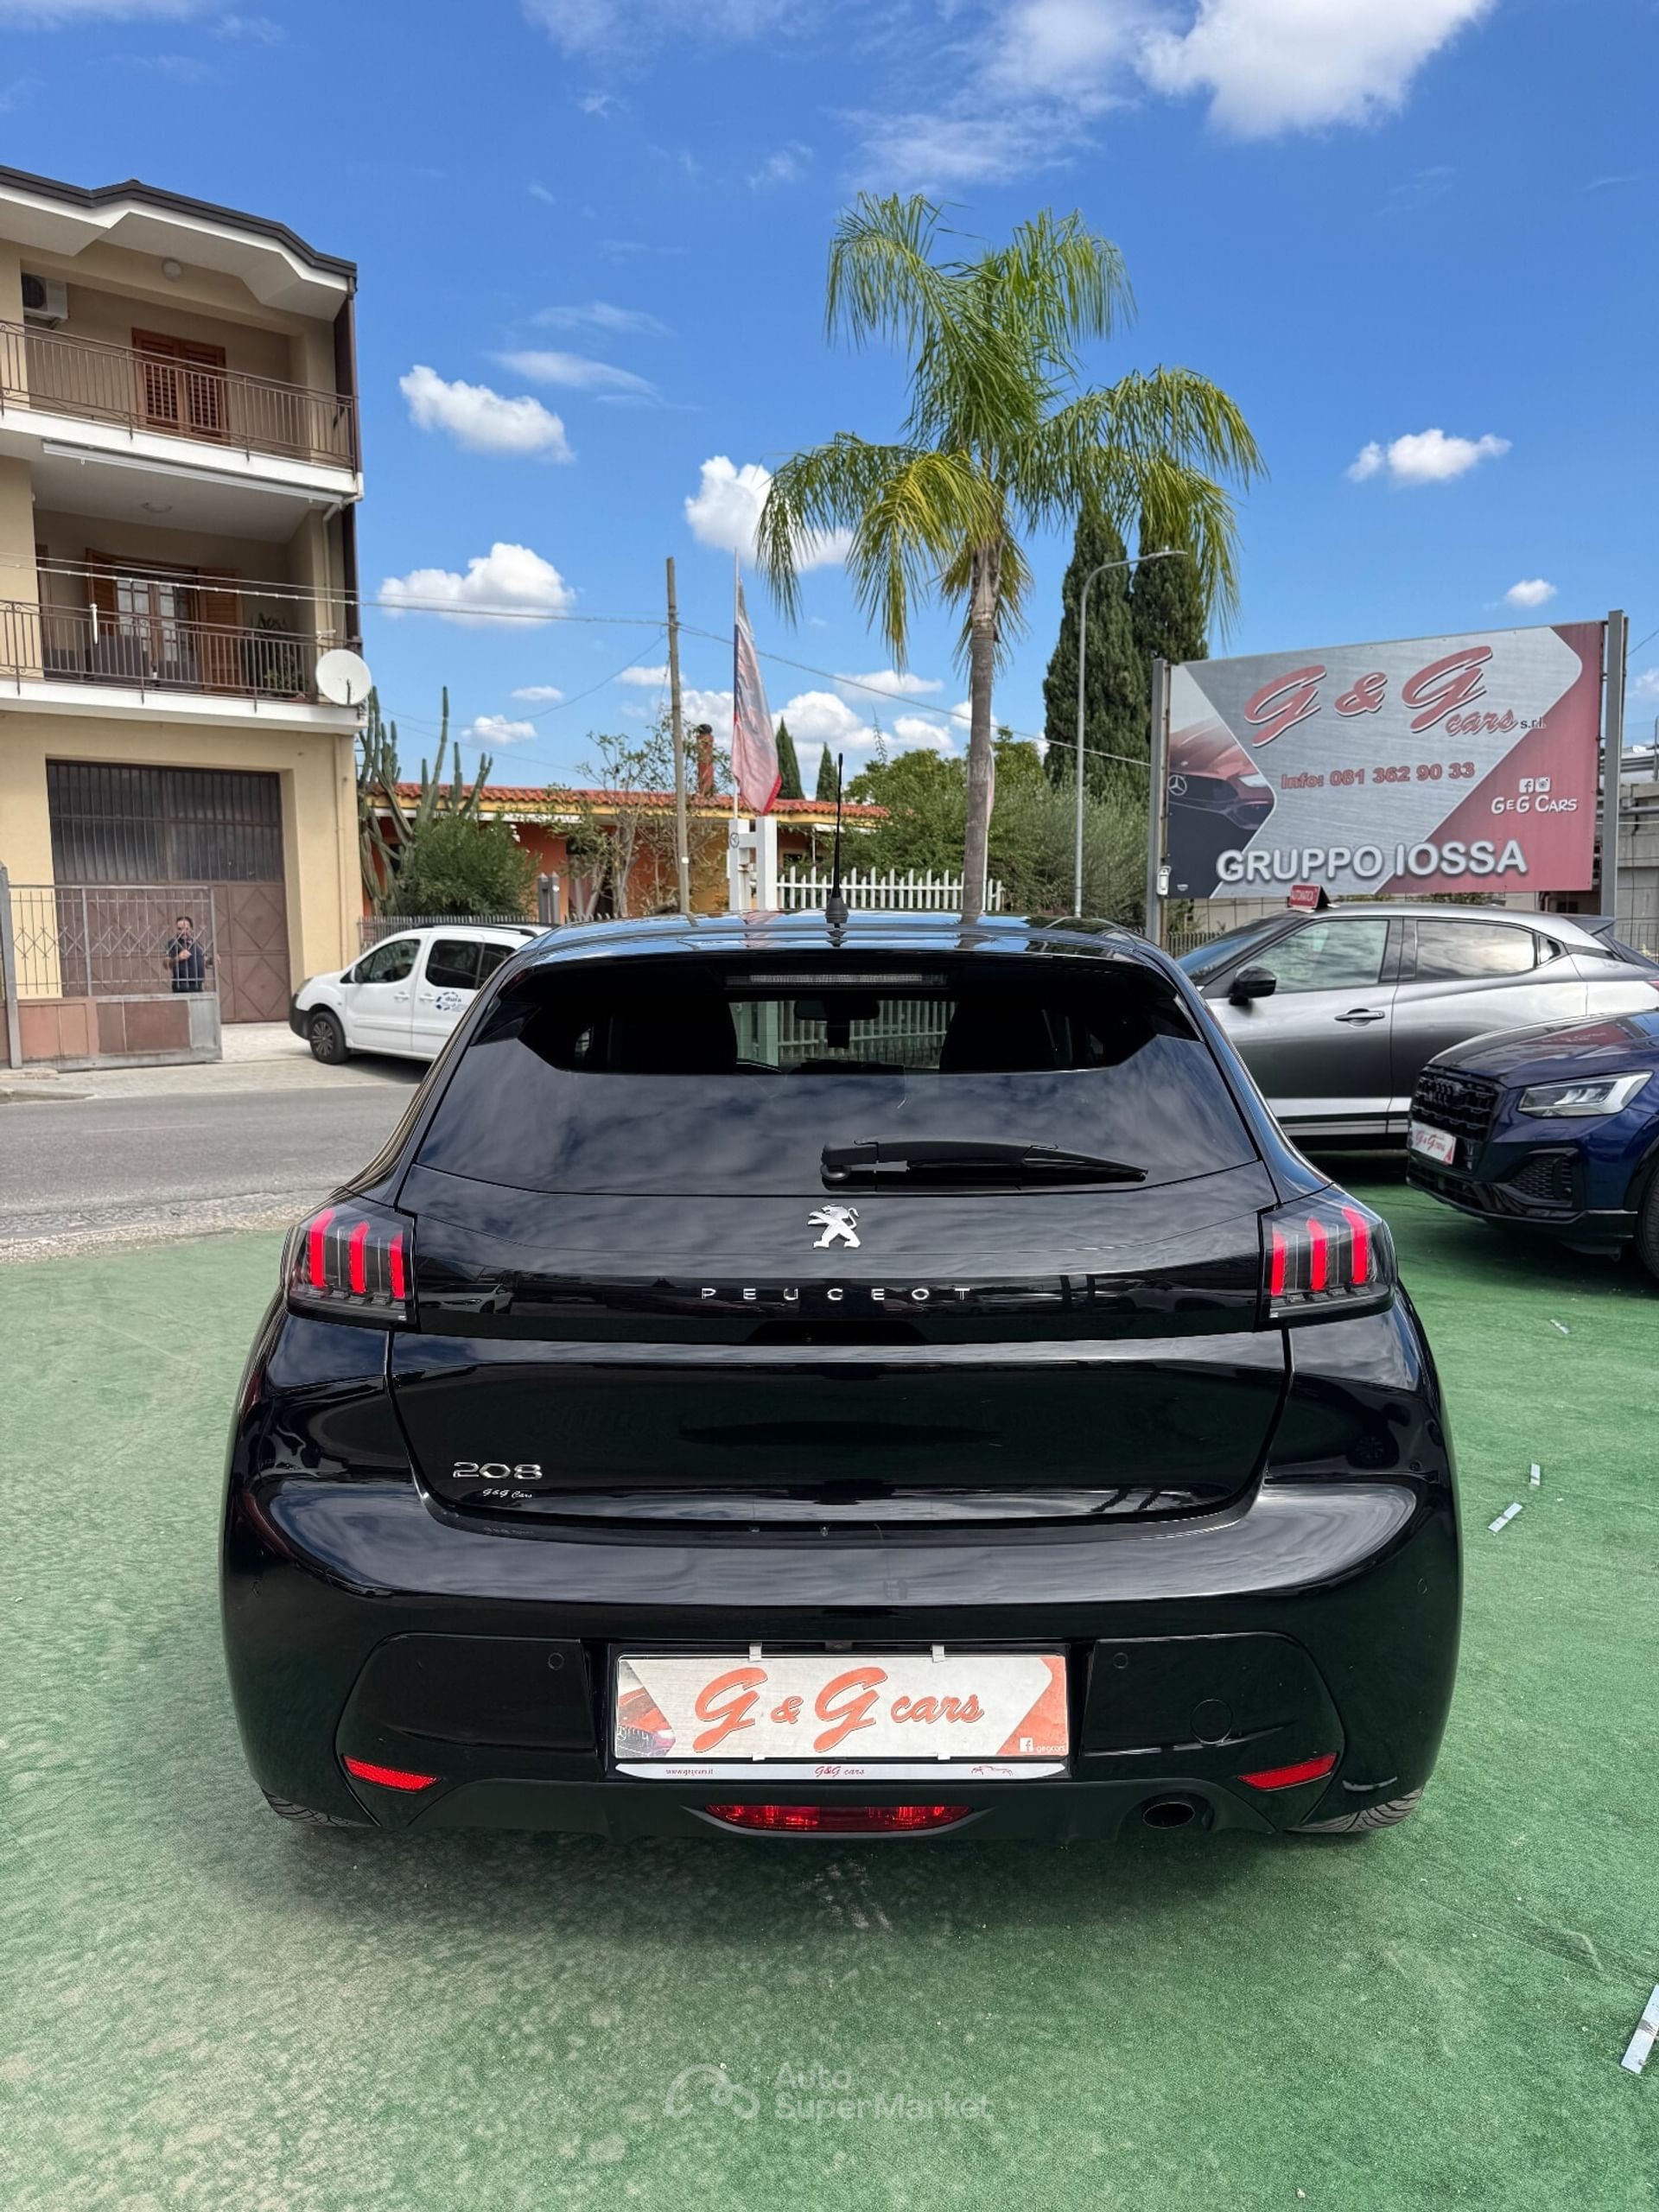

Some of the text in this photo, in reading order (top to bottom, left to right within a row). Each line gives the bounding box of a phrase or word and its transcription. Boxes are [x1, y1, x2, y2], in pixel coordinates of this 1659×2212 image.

[1243, 645, 1493, 748] G & G
[1445, 709, 1518, 737] cars
[1281, 761, 1476, 790] Info: 081 362 90 33
[1217, 839, 1529, 881] GRUPPO IOSSA
[701, 1287, 970, 1301] PEUGEOT
[452, 1461, 543, 1480] 208
[692, 1667, 985, 1753] G & G cars
